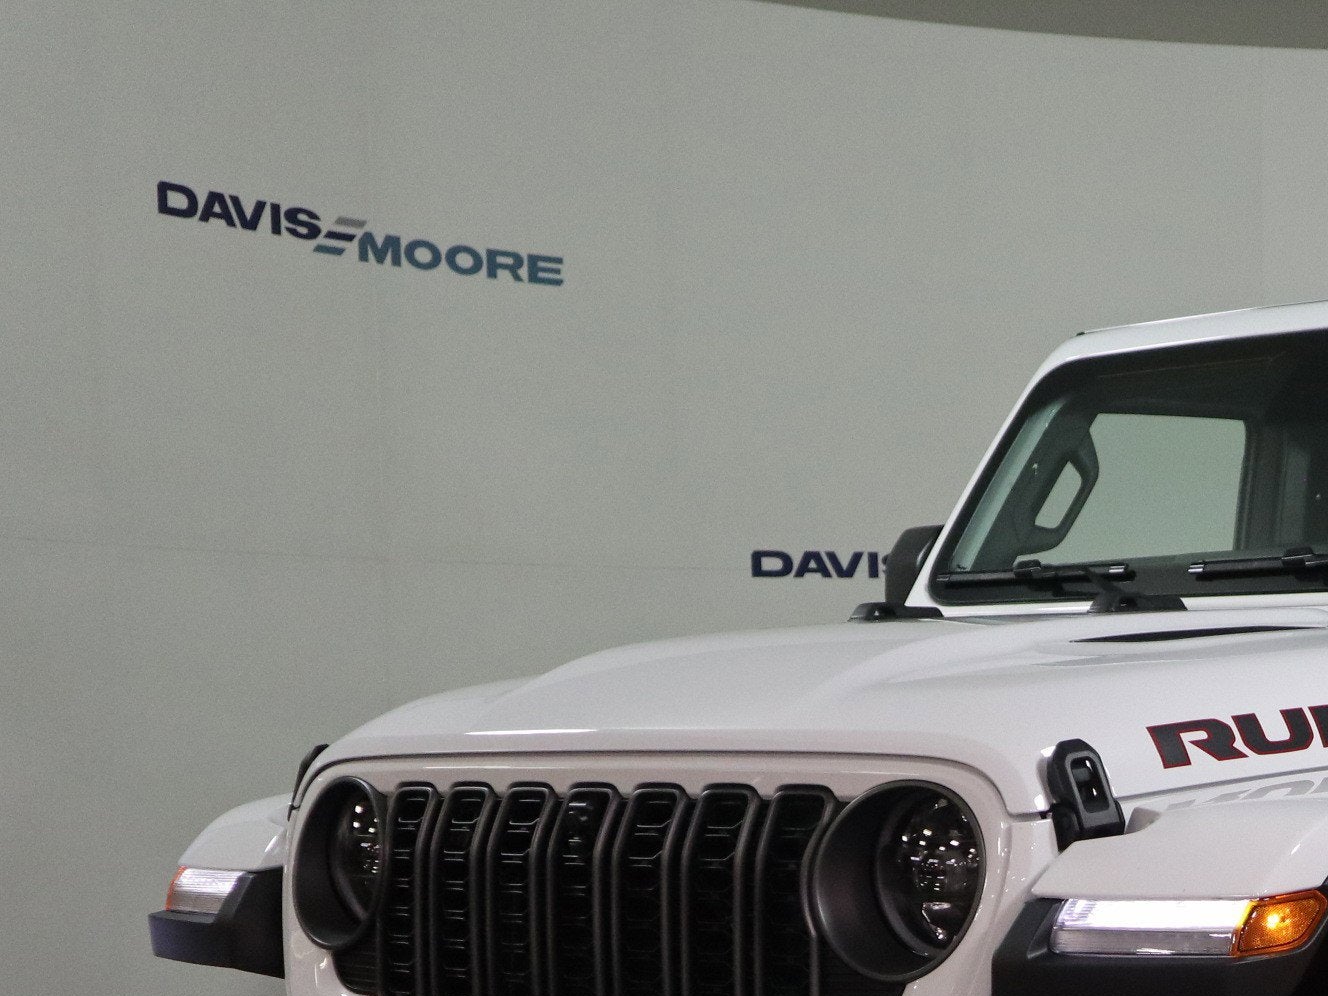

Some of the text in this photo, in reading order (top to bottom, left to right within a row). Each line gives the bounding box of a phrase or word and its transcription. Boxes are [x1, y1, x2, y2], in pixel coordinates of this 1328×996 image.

[156, 180, 565, 287] DAVIS MOORE
[750, 549, 889, 579] DAVI
